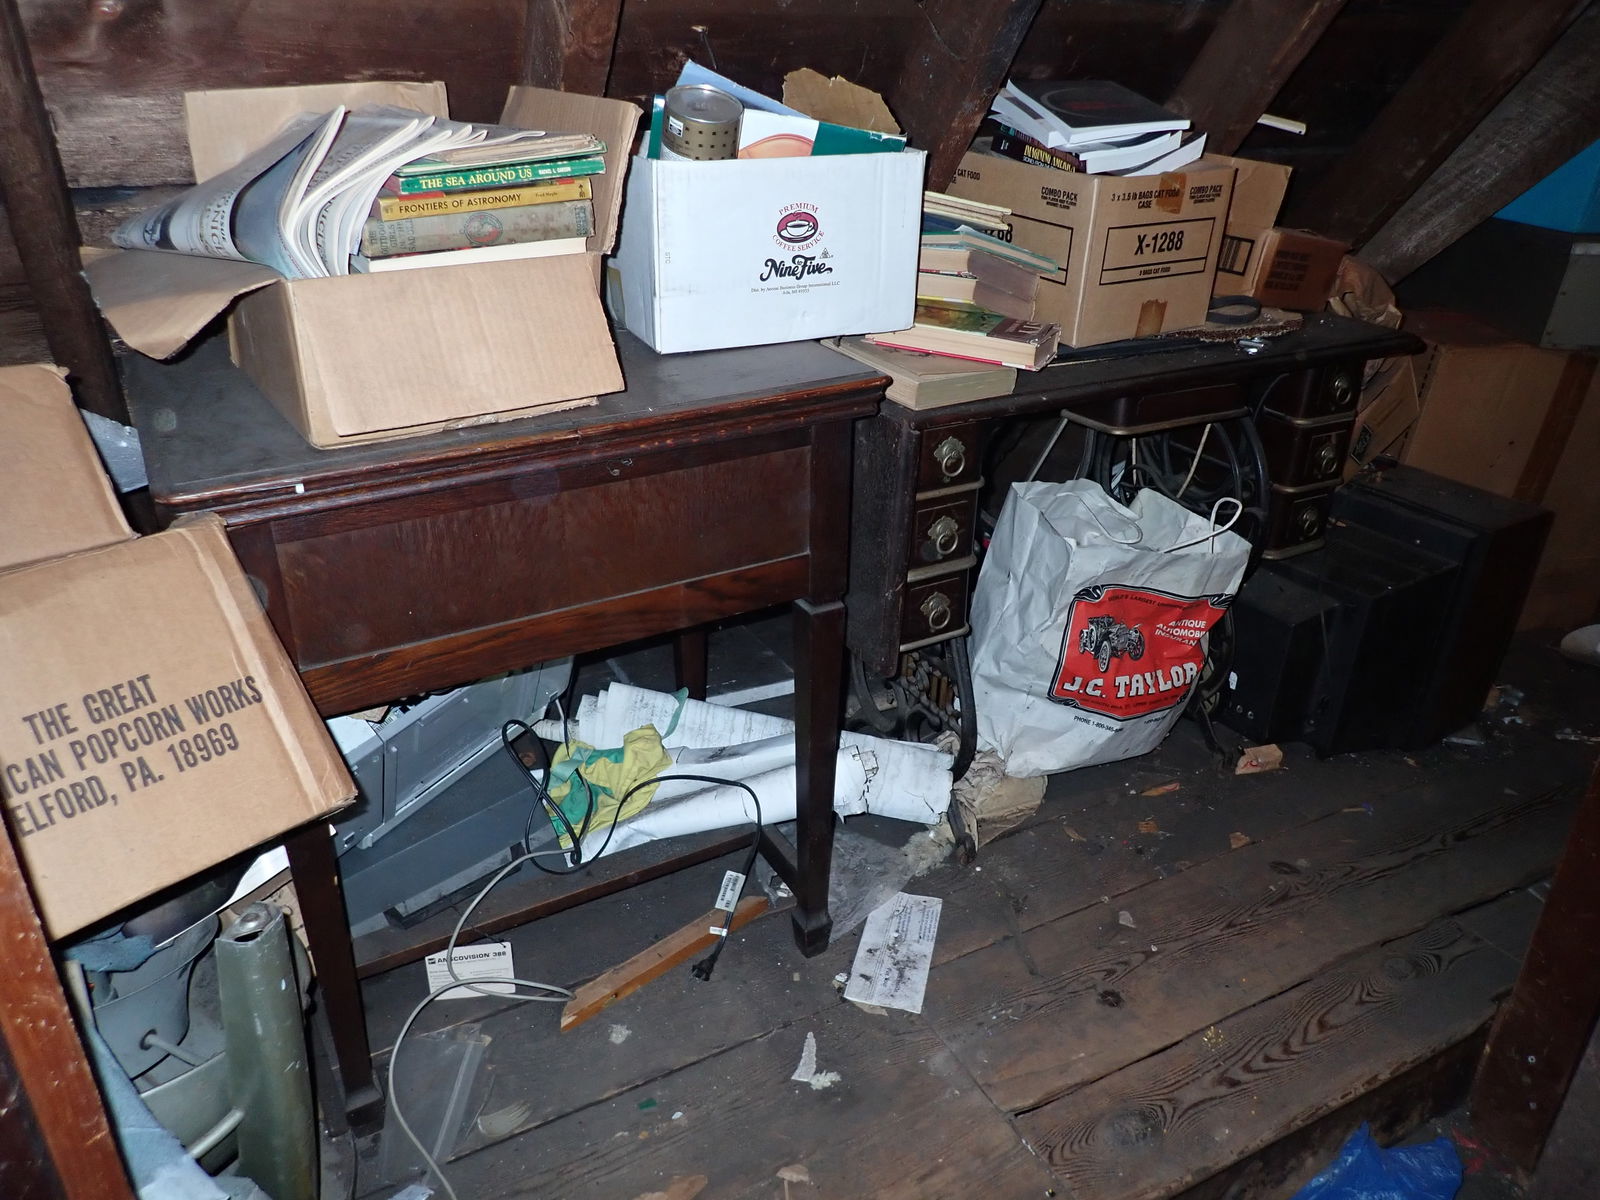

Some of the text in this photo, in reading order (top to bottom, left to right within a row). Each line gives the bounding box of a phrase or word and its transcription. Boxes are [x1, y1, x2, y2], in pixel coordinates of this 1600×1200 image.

[419, 167, 533, 190] THE SEA AROUND US
[957, 168, 966, 177] CAT
[966, 170, 981, 181] FOOD
[1041, 186, 1078, 202] COMBO PACK
[1111, 193, 1116, 201] 3
[1121, 192, 1132, 201] 3.5
[1138, 189, 1153, 200] BAGS
[1153, 189, 1164, 199] CAT
[1163, 188, 1181, 198] FOOD
[1189, 184, 1224, 195] COMBO PACK
[399, 193, 522, 214] FRONTIERS OF ASTRONOMY
[778, 202, 820, 216] PREMIUM
[1137, 200, 1152, 209] CASE
[772, 230, 825, 252] COFFEE SERVICE
[1134, 230, 1185, 256] X-1288
[759, 258, 800, 282] Nine
[791, 254, 834, 281] Five
[1155, 623, 1207, 639] AUTOMOBI
[1168, 619, 1207, 629] ANTIQUE
[1154, 629, 1198, 647] INSURAN
[1063, 661, 1198, 699] J.C. TAYLOR
[22, 673, 159, 745] THE GREAT
[69, 704, 186, 771] POPCORN
[184, 675, 264, 725] WORKS
[1073, 715, 1125, 733] PHONE 1-800-345-
[10, 722, 240, 837] ELFORD, PA. 18969
[437, 952, 490, 964] ANCOVISION
